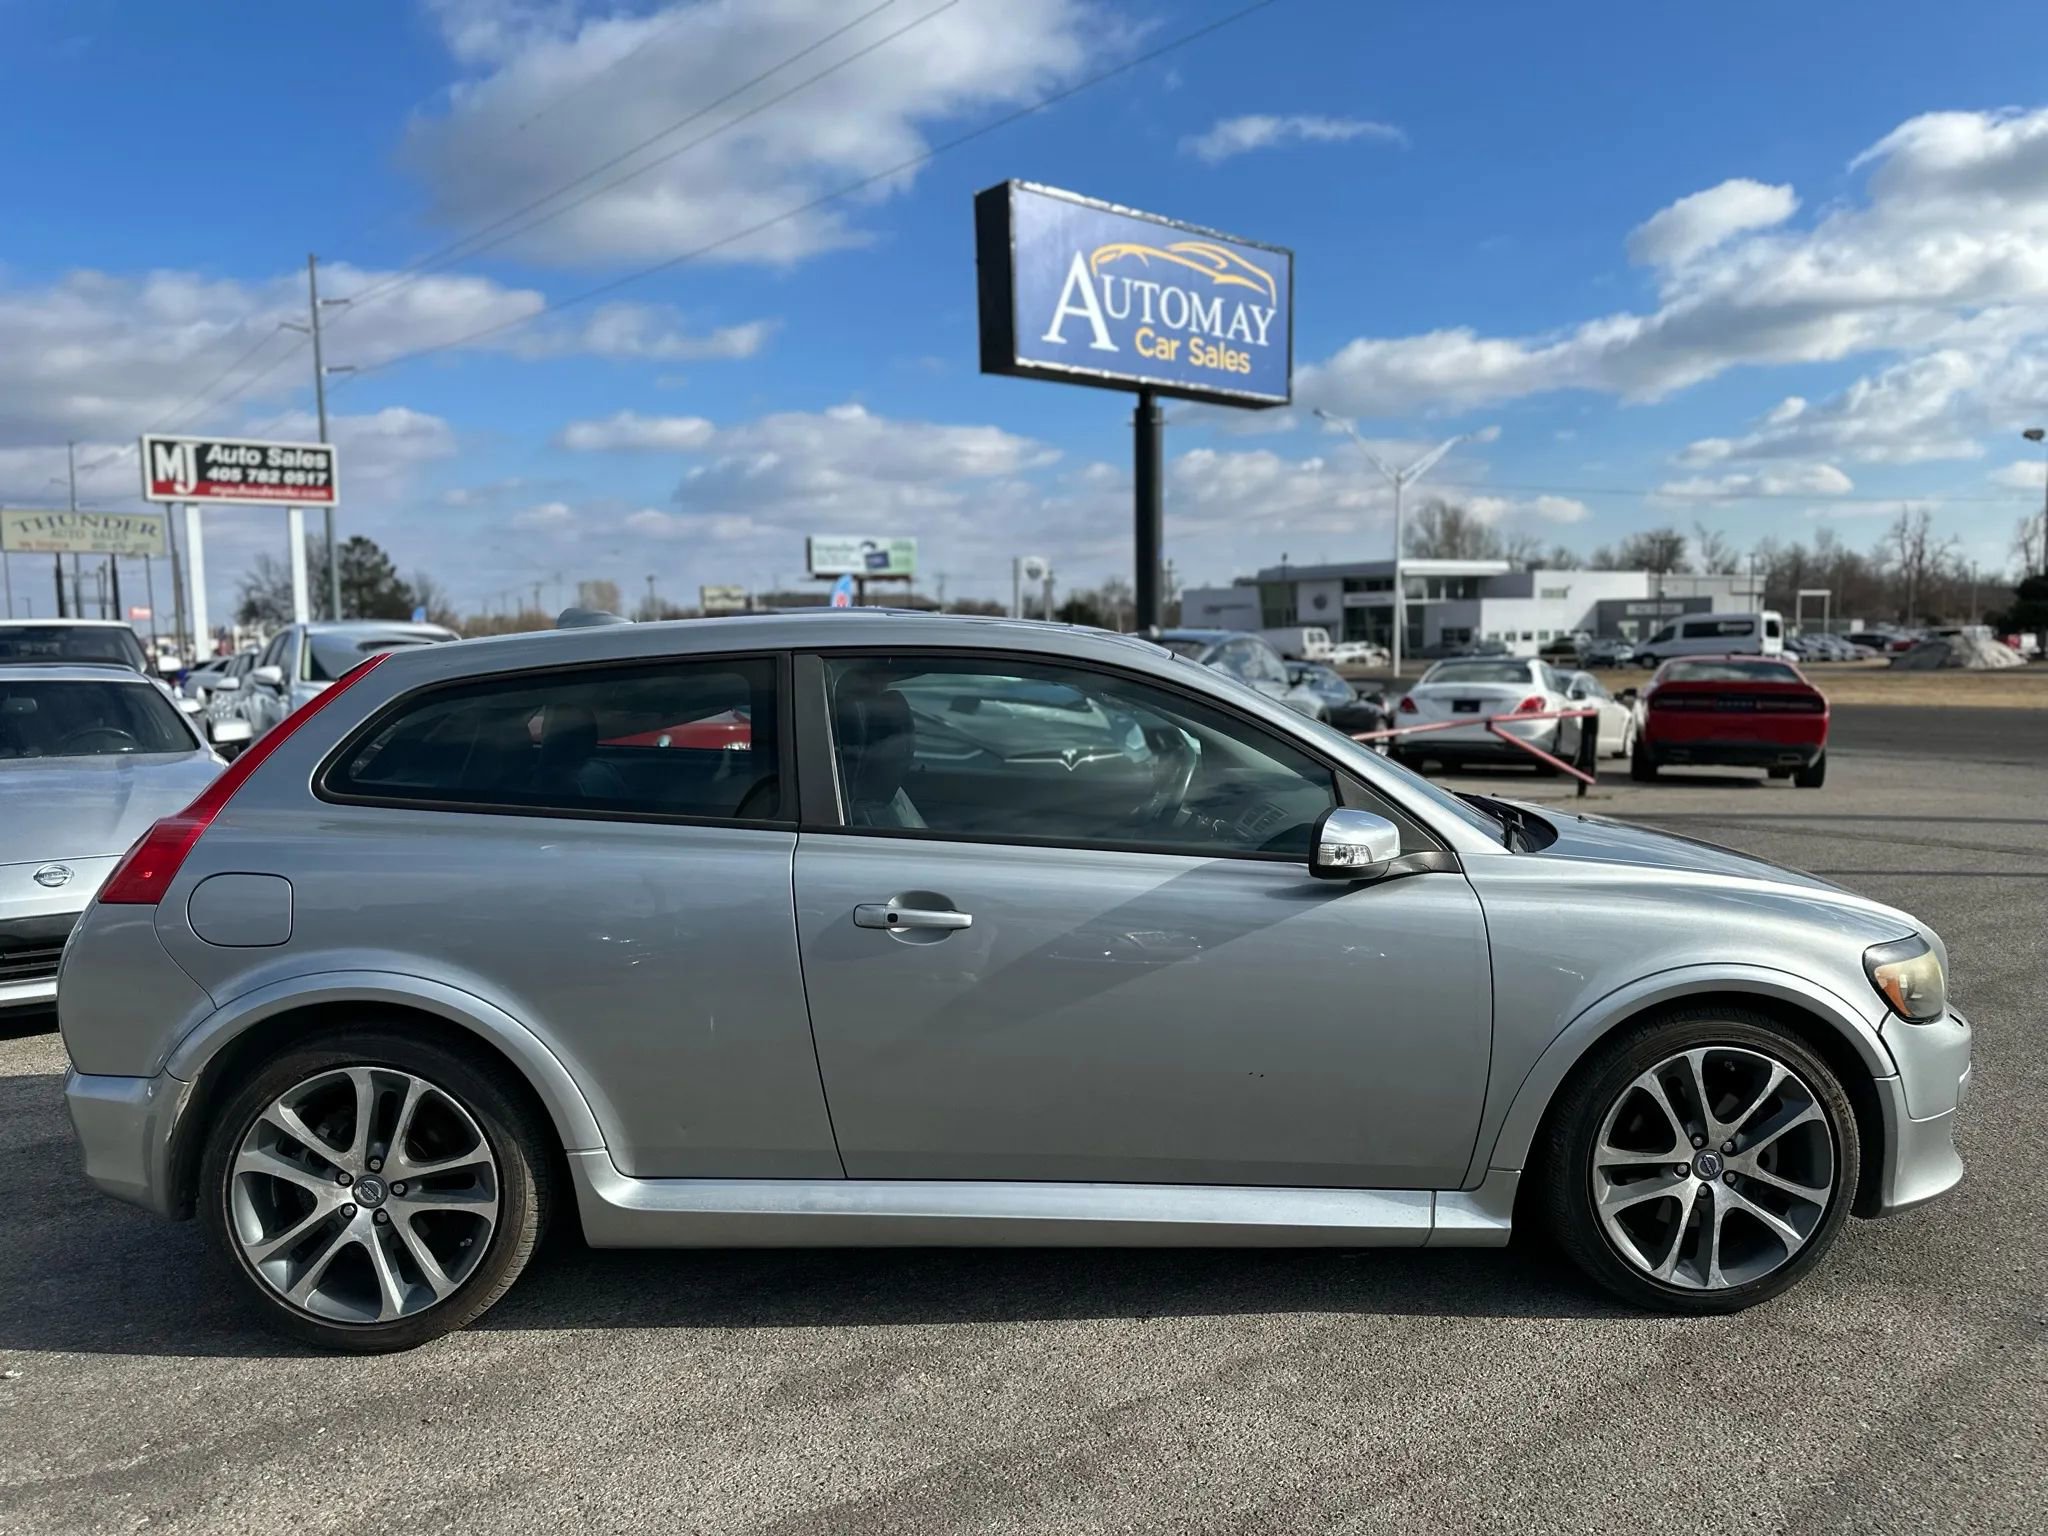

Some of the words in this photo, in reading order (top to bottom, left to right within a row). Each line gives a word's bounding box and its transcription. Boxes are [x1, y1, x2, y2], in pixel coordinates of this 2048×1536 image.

[1135, 326, 1181, 361] Car
[1188, 336, 1251, 374] Sales
[153, 442, 201, 495] MJ
[206, 445, 262, 466] Auto
[266, 448, 328, 469] Sales
[206, 467, 242, 482] 405
[246, 469, 279, 484] 782
[11, 513, 158, 538] THUNDER
